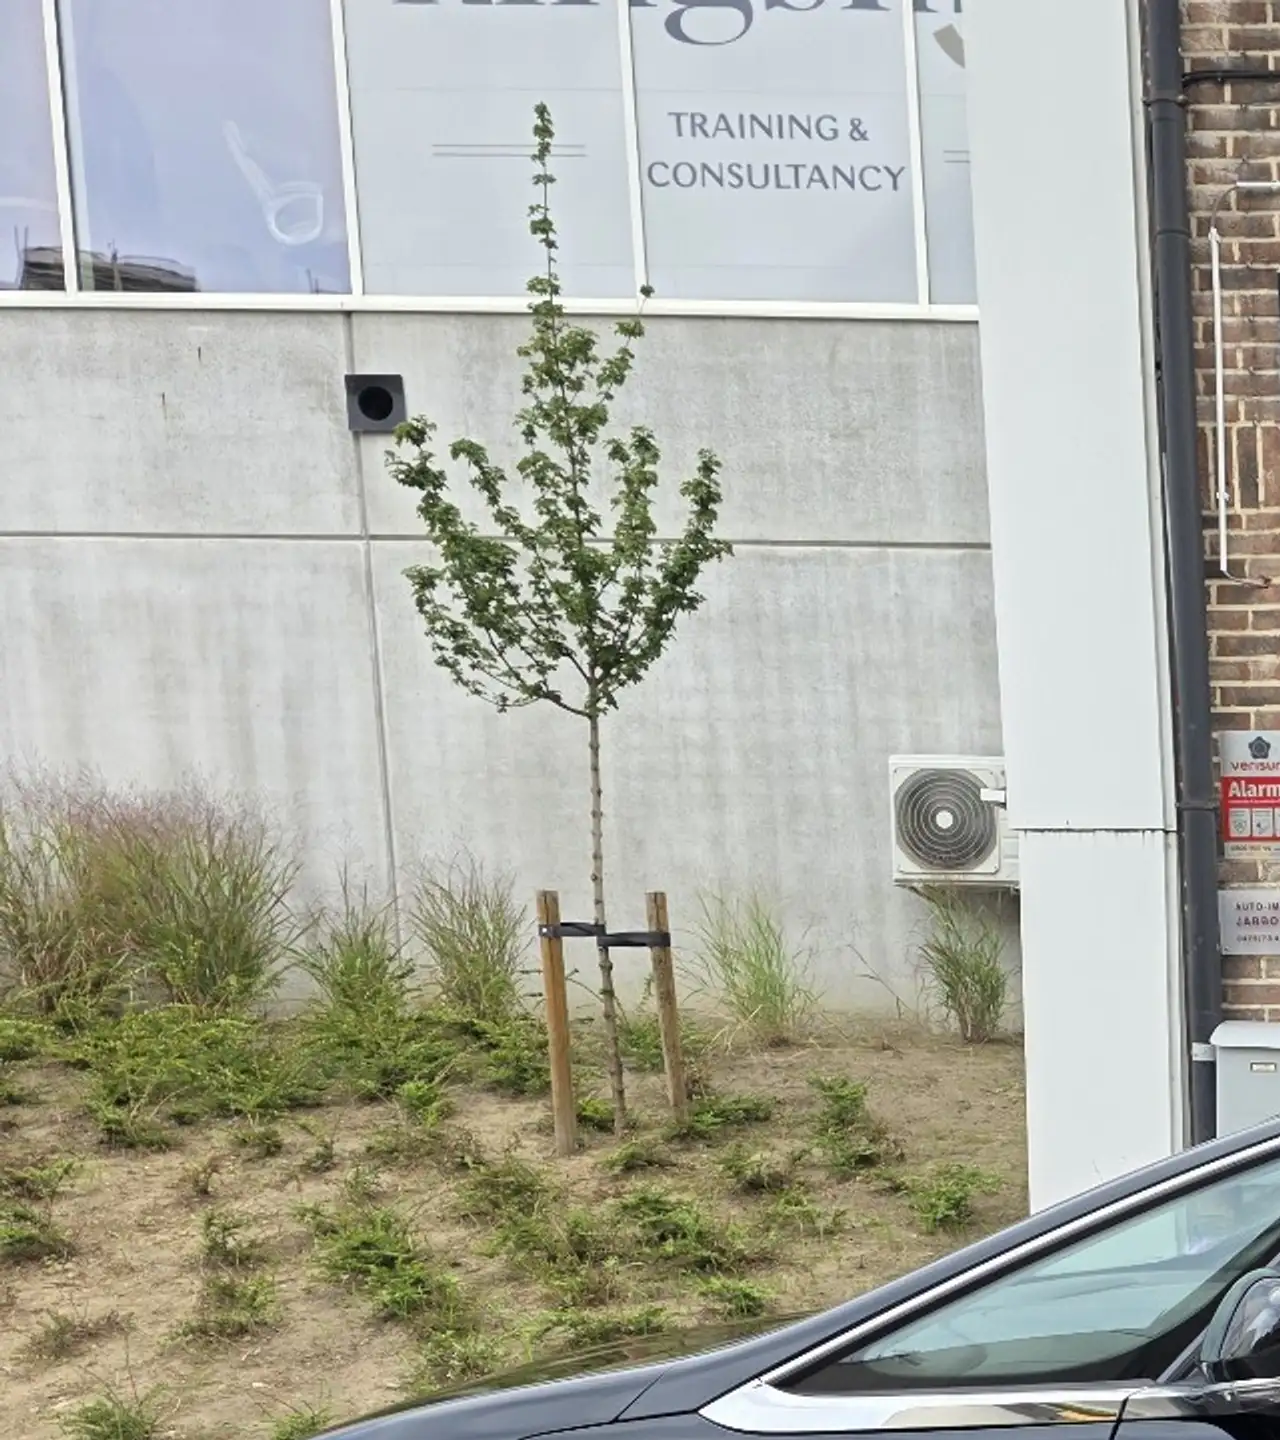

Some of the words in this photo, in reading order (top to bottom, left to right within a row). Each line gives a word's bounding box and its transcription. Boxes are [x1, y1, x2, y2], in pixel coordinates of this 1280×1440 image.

[667, 111, 839, 142] TRAINING
[849, 117, 870, 143] &
[646, 160, 906, 193] CONSULTANCY
